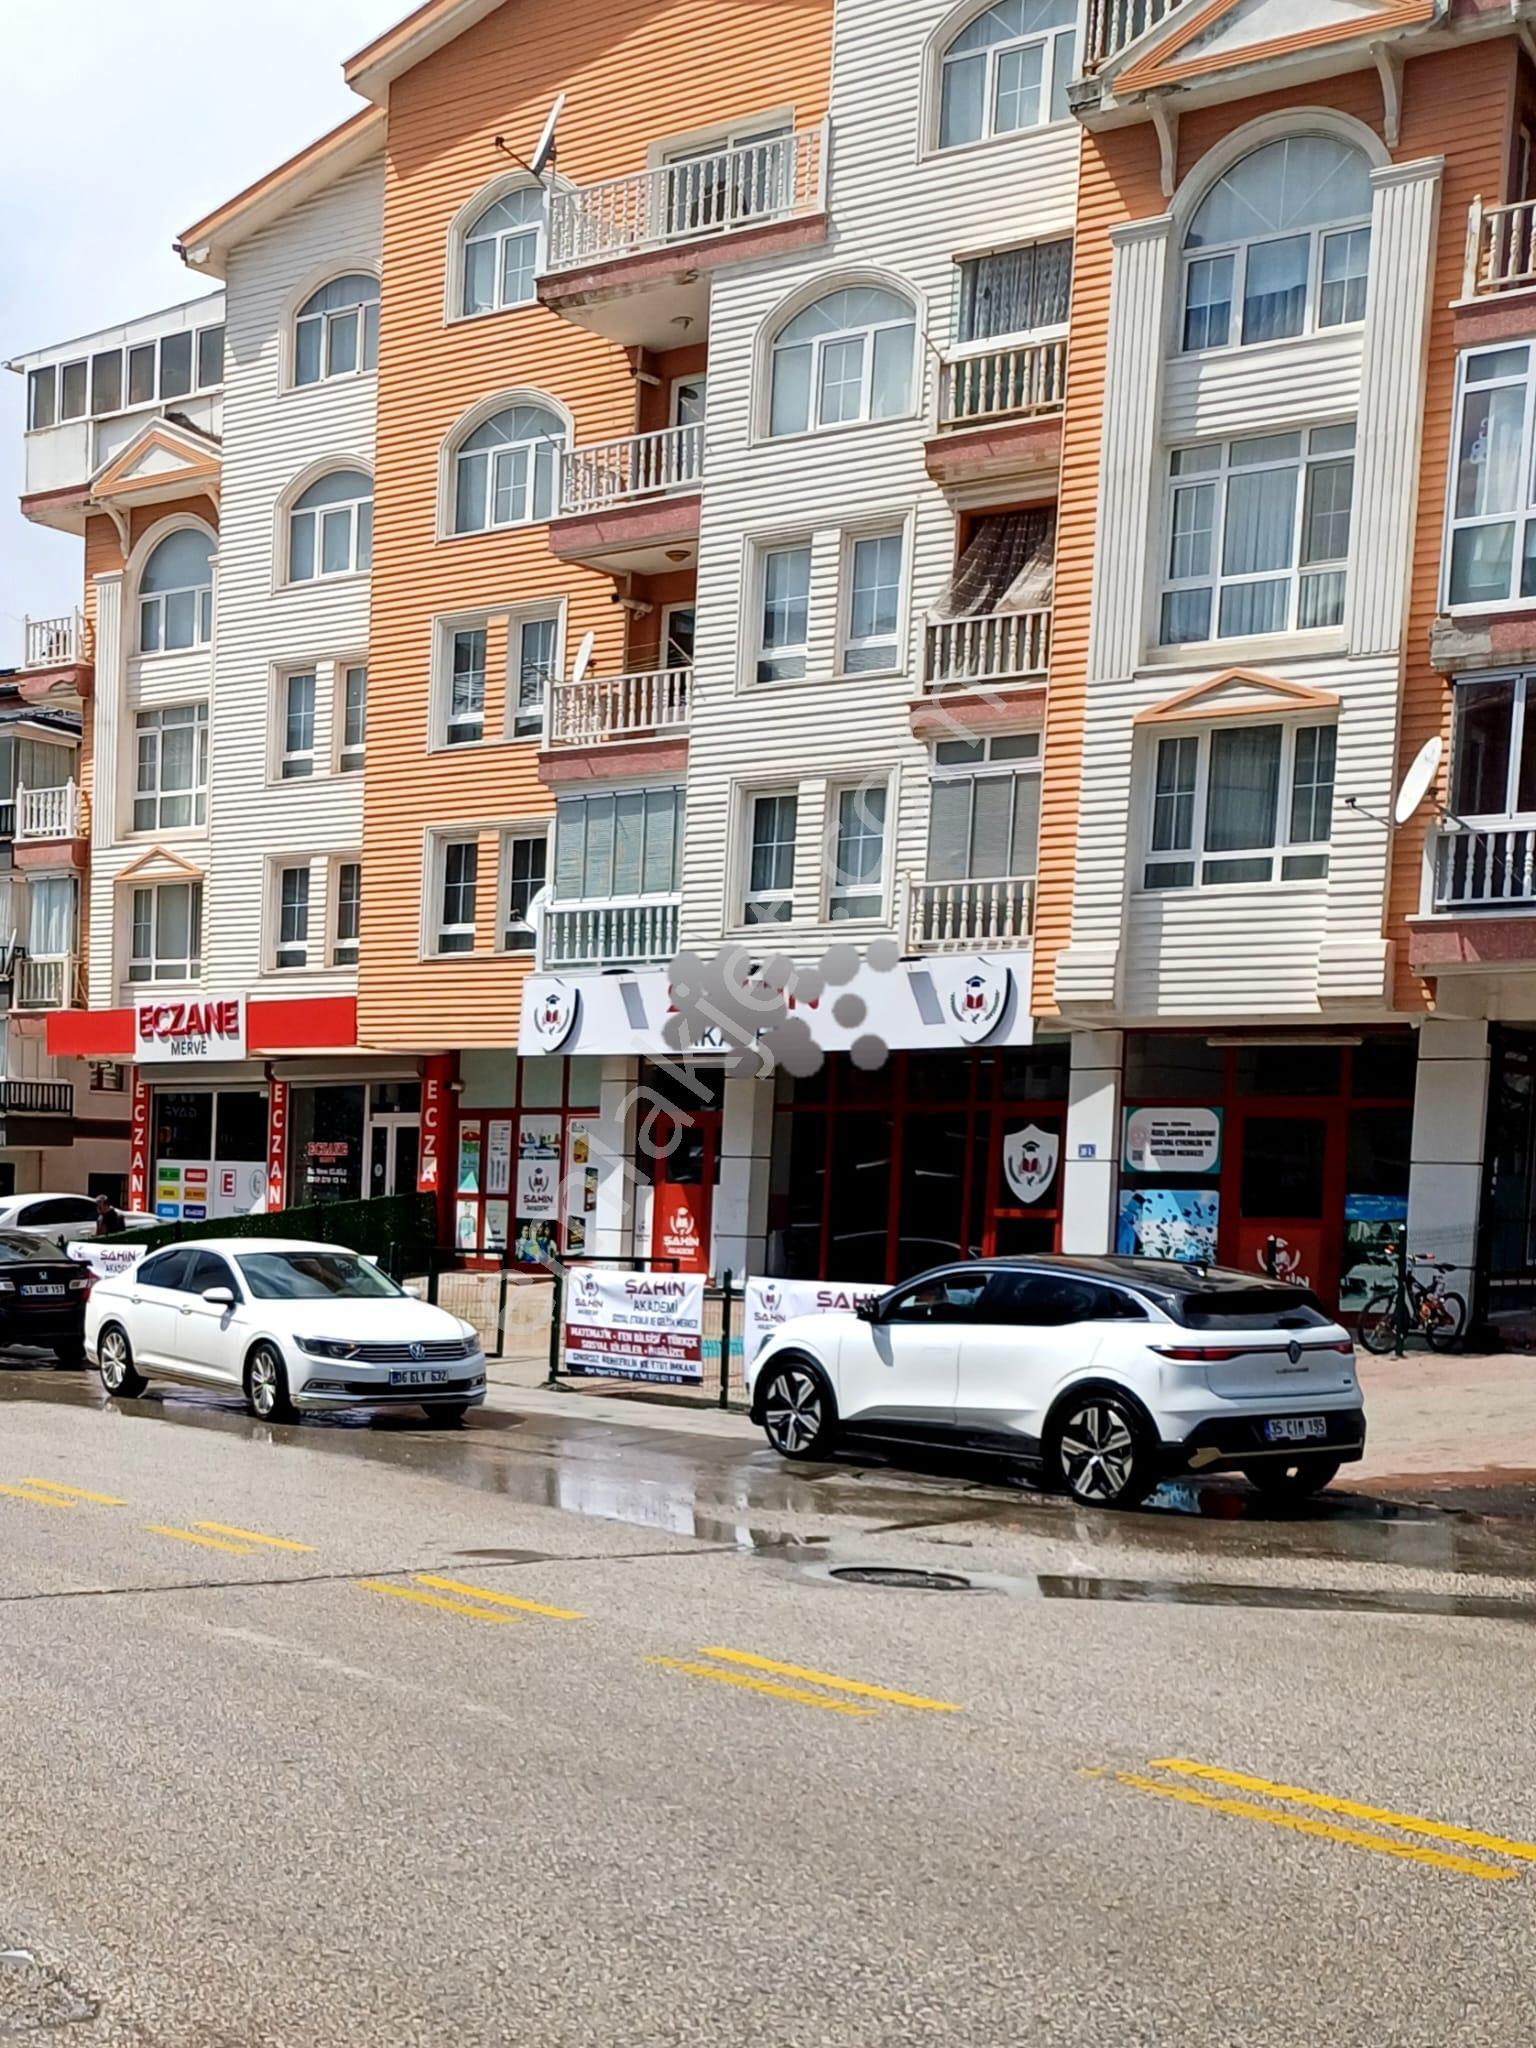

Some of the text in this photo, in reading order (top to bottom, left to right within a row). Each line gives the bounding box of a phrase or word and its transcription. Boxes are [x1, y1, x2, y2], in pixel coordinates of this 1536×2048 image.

[140, 1000, 239, 1038] ECZANE
[171, 1041, 207, 1056] MERVE
[269, 1084, 283, 1204] ECZAN
[420, 1080, 438, 1183] ECZA
